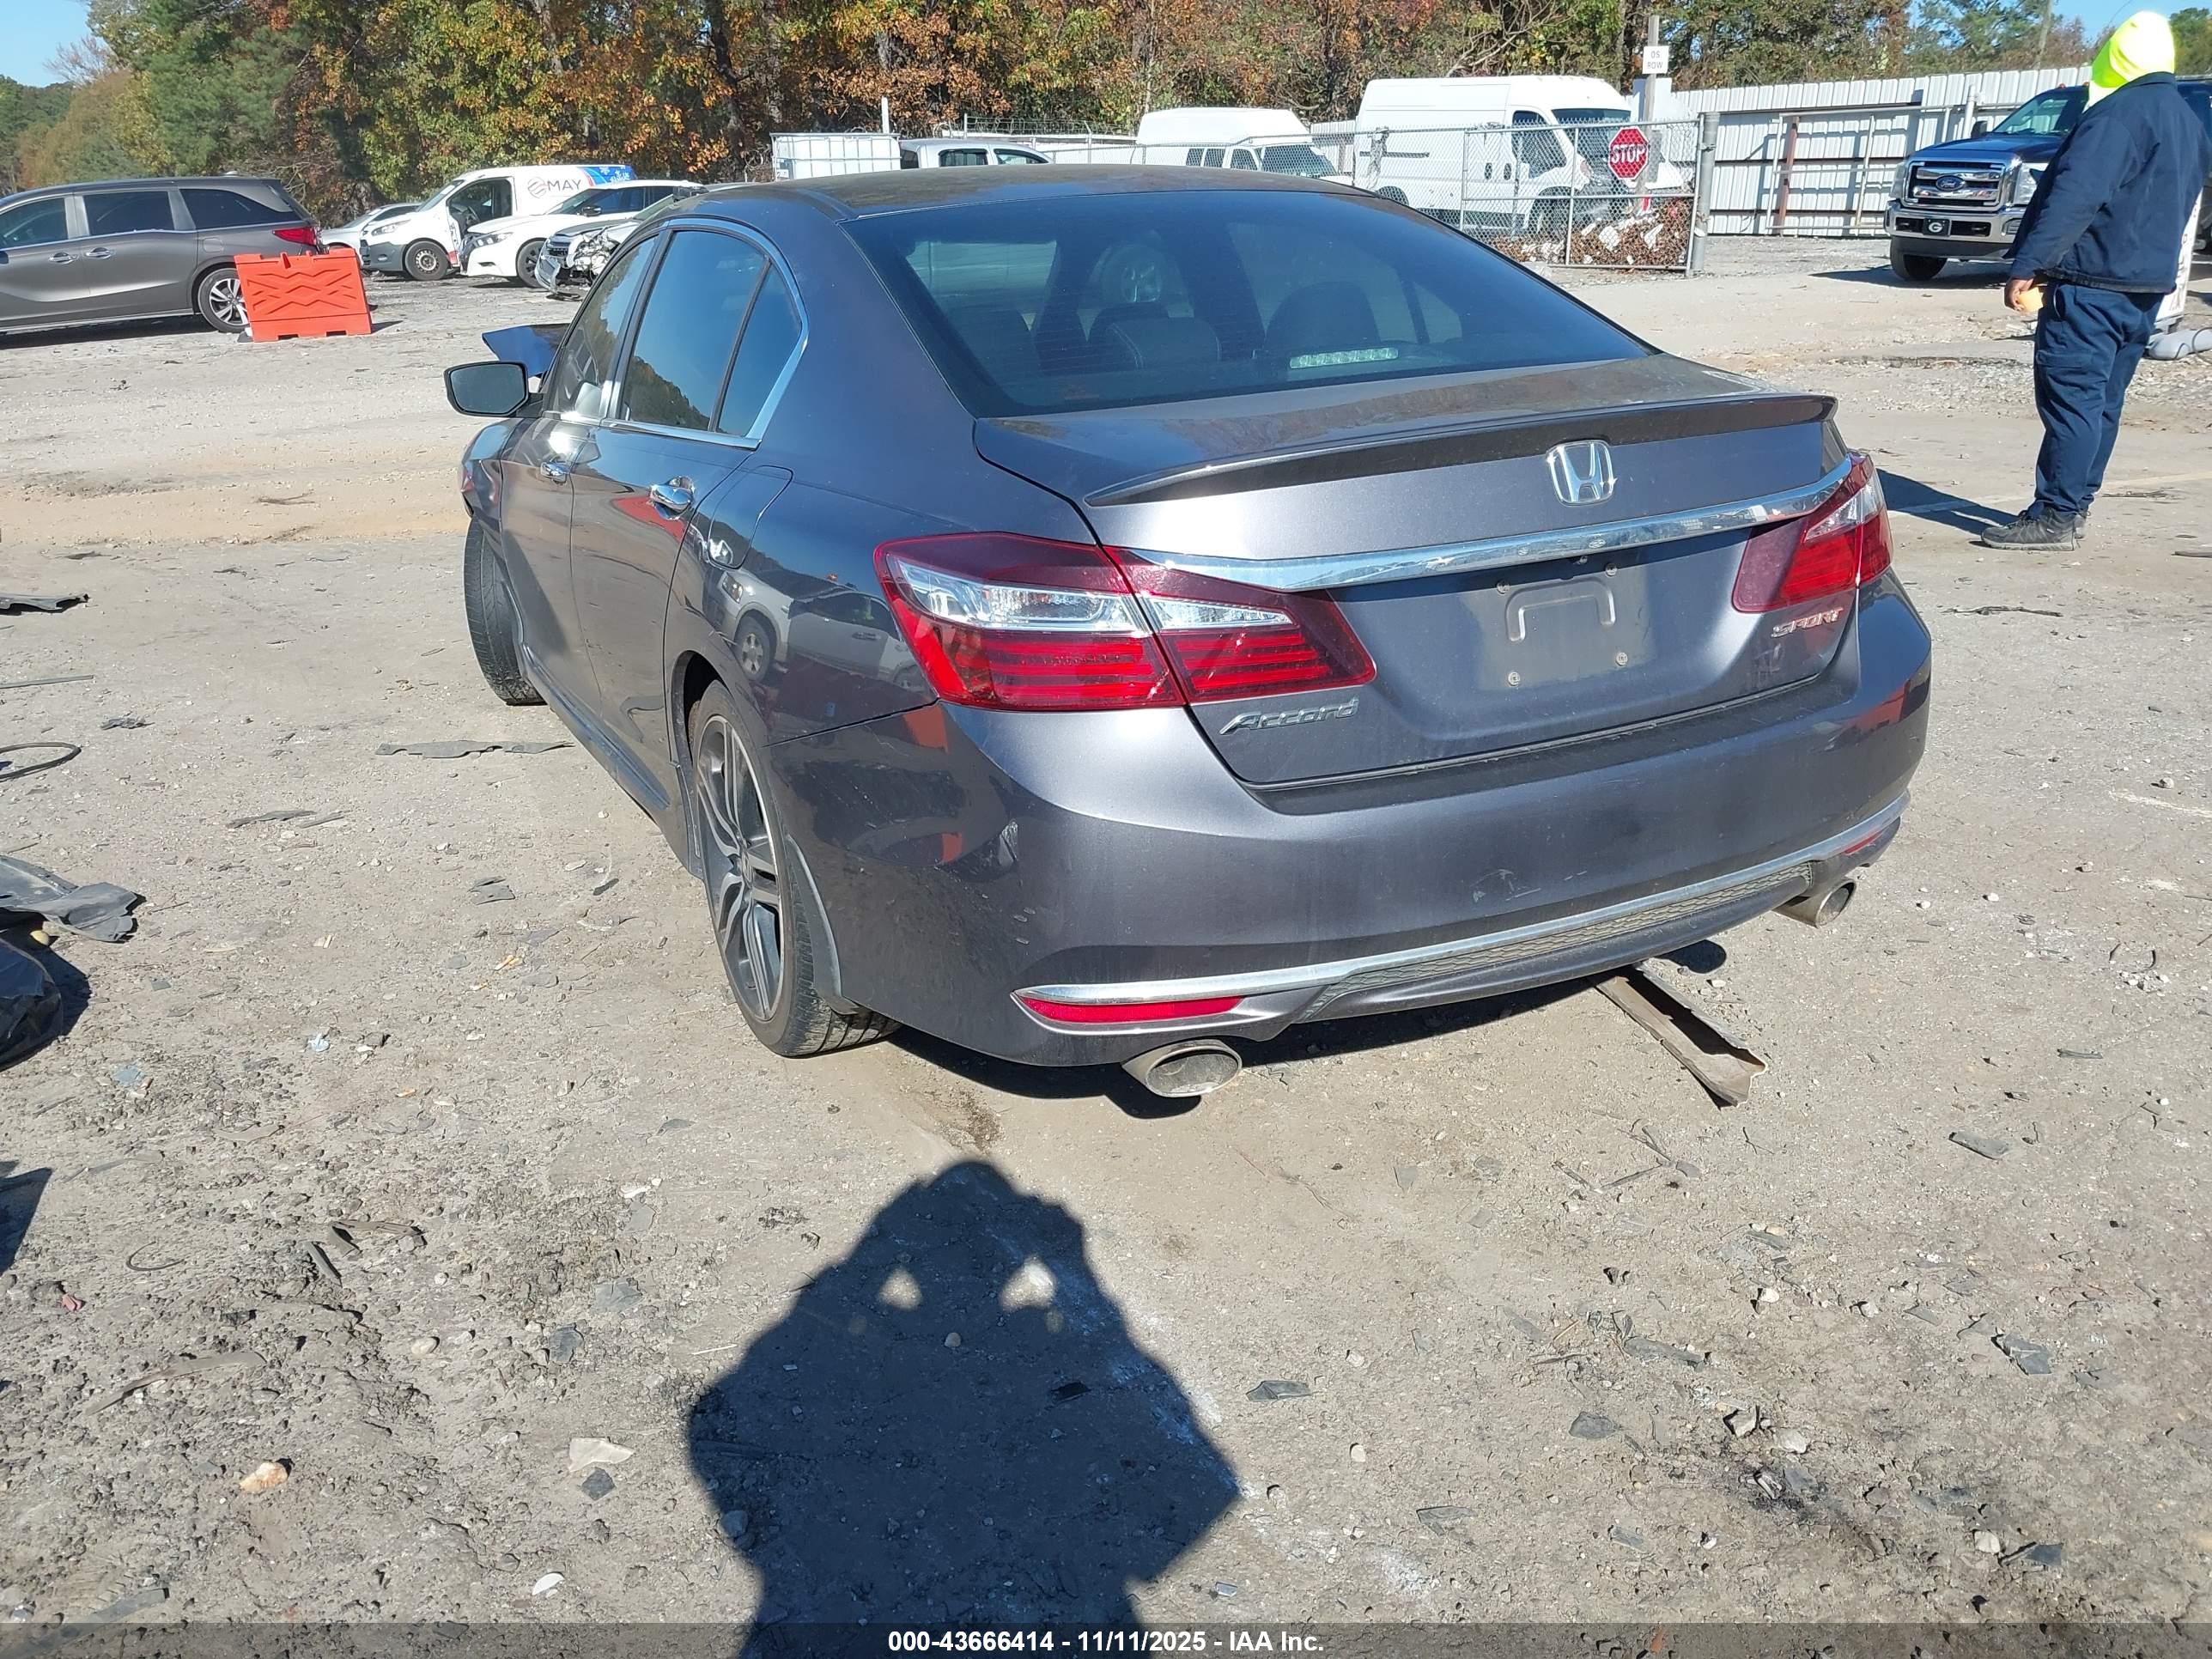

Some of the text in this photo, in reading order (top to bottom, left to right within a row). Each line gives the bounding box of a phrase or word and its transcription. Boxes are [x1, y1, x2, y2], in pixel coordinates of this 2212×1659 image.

[1611, 143, 1645, 163] STOP
[1771, 606, 1844, 638] SPORT
[1219, 696, 1359, 735] Accord
